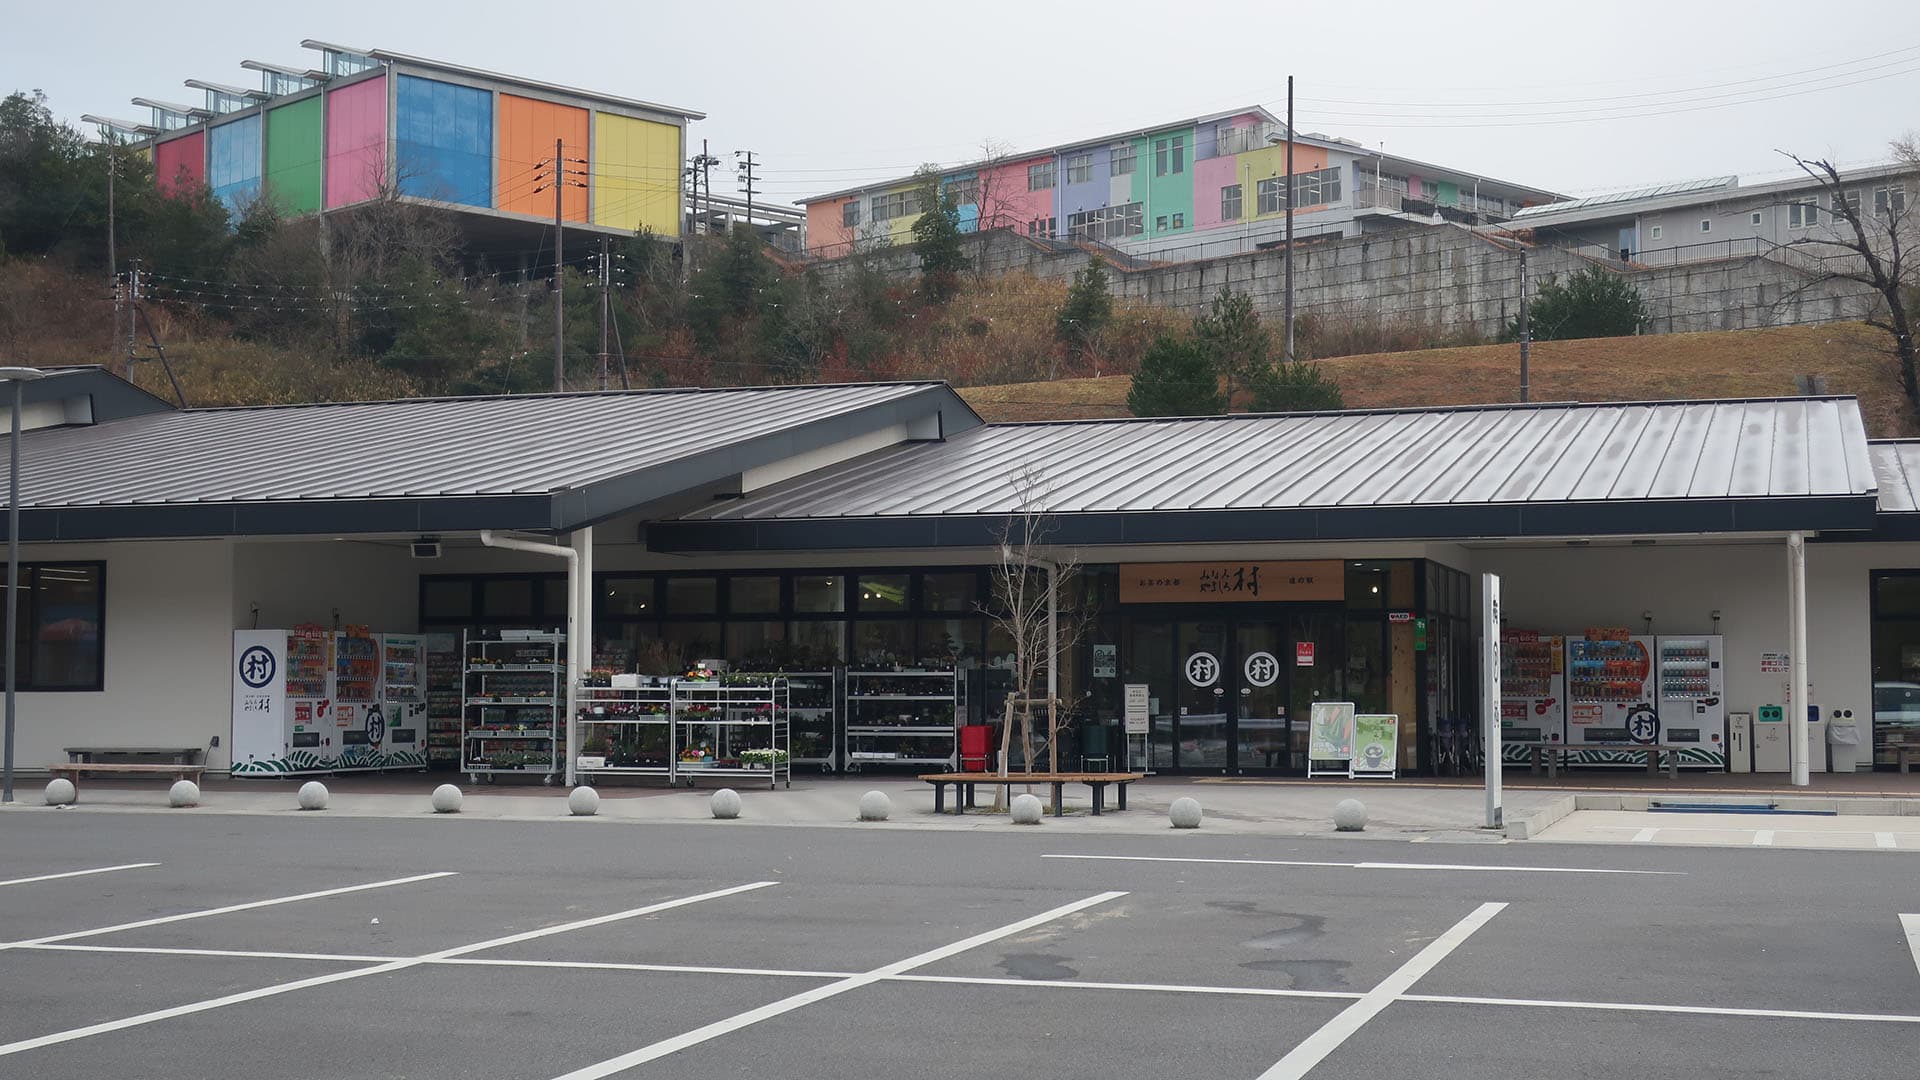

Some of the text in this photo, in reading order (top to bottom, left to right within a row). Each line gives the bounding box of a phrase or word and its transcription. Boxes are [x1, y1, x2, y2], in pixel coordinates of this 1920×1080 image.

[1231, 566, 1260, 597] 村
[245, 654, 269, 680] 村
[1191, 658, 1214, 680] 村
[1250, 658, 1273, 680] 村
[368, 716, 382, 739] 村
[1631, 714, 1655, 737] 村
